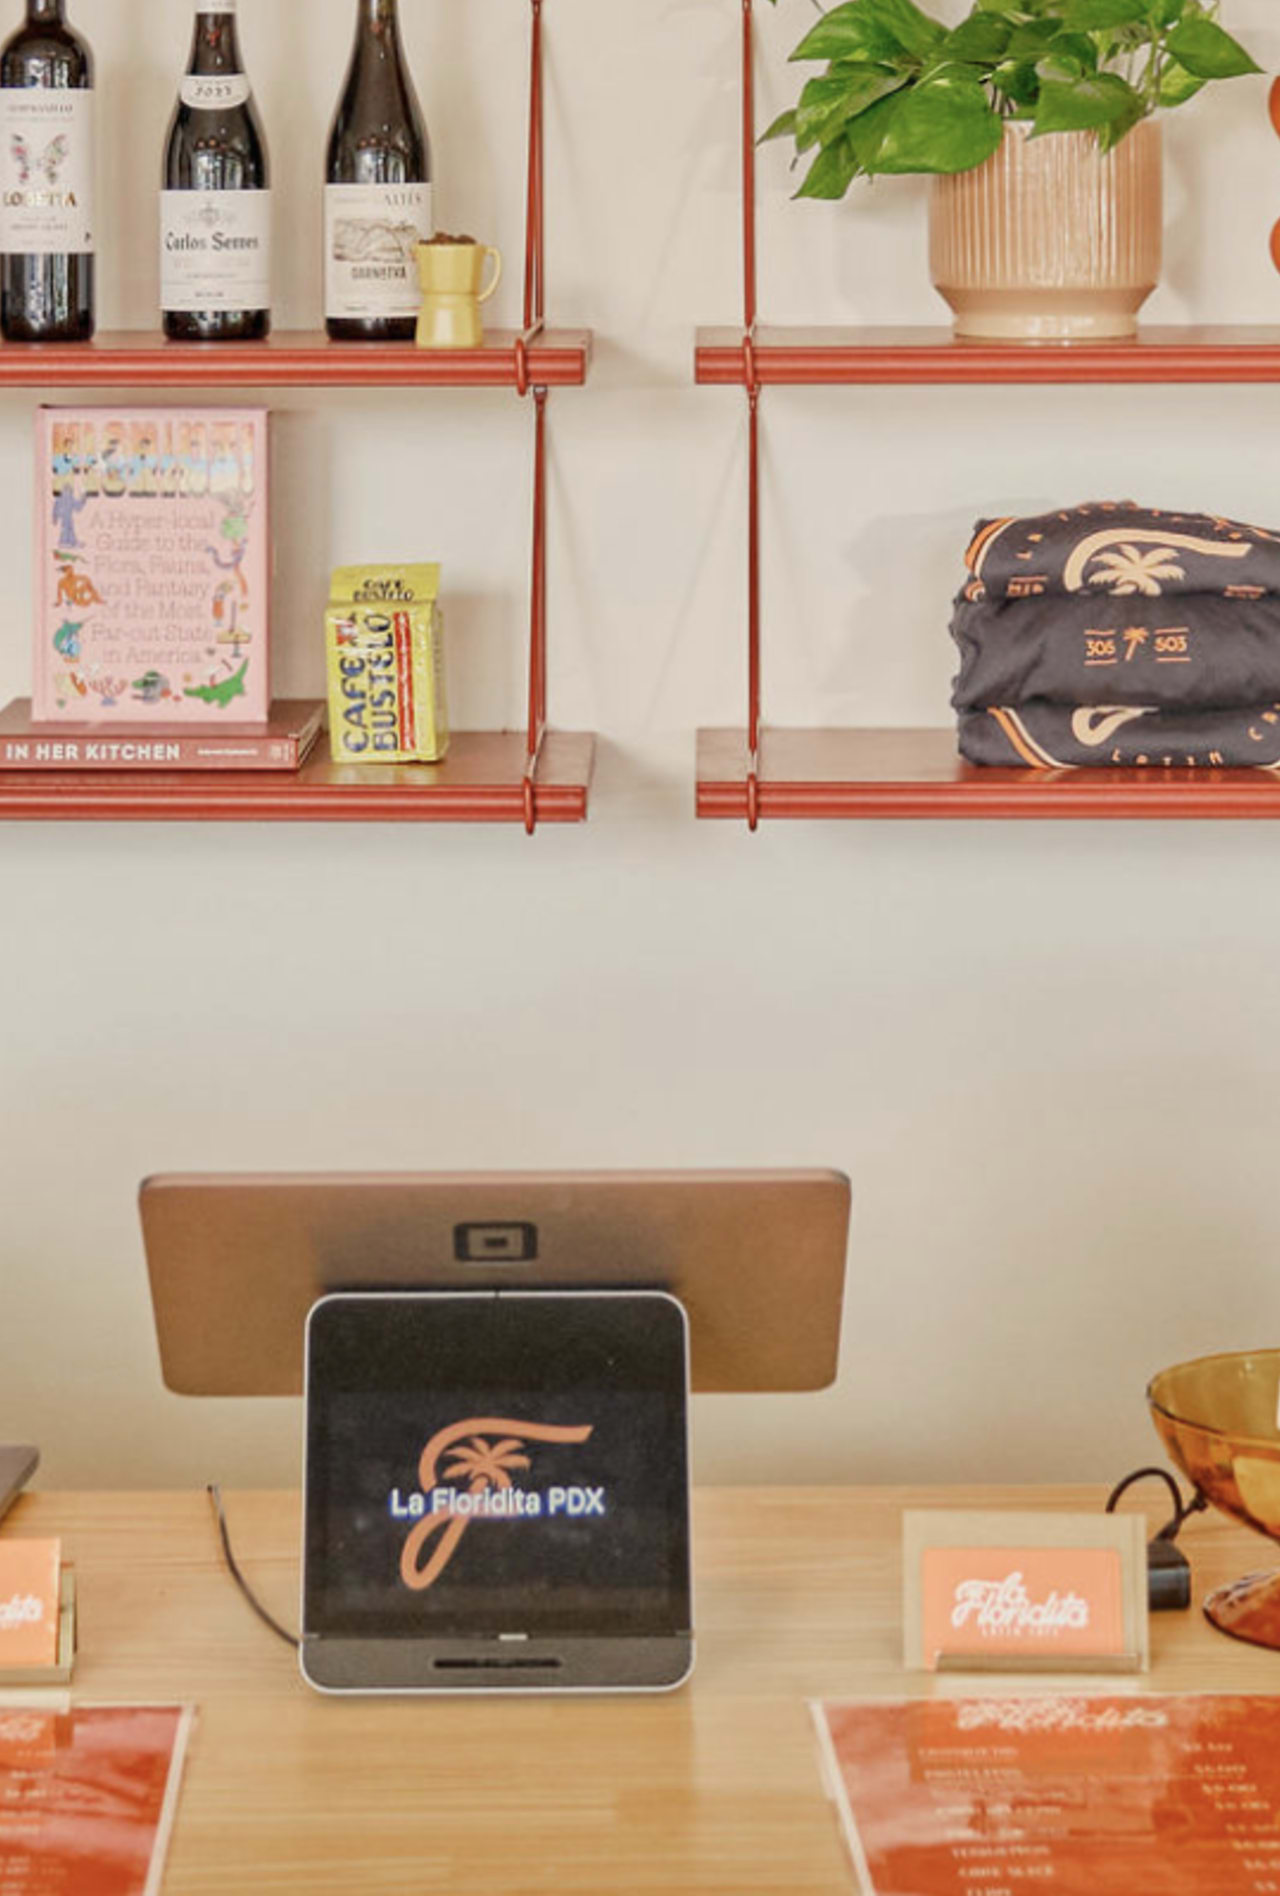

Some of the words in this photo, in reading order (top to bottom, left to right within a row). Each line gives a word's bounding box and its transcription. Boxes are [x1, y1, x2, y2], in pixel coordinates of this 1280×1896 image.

[166, 232, 207, 251] Carlos
[363, 612, 399, 752] BUSTELO
[6, 744, 29, 760] IN
[35, 744, 78, 760] HER
[86, 744, 180, 760] KITCHEN
[391, 1488, 426, 1516] La
[432, 1486, 542, 1517] Floridita
[548, 1487, 607, 1516] PDX
[950, 1579, 1089, 1629] Floridita
